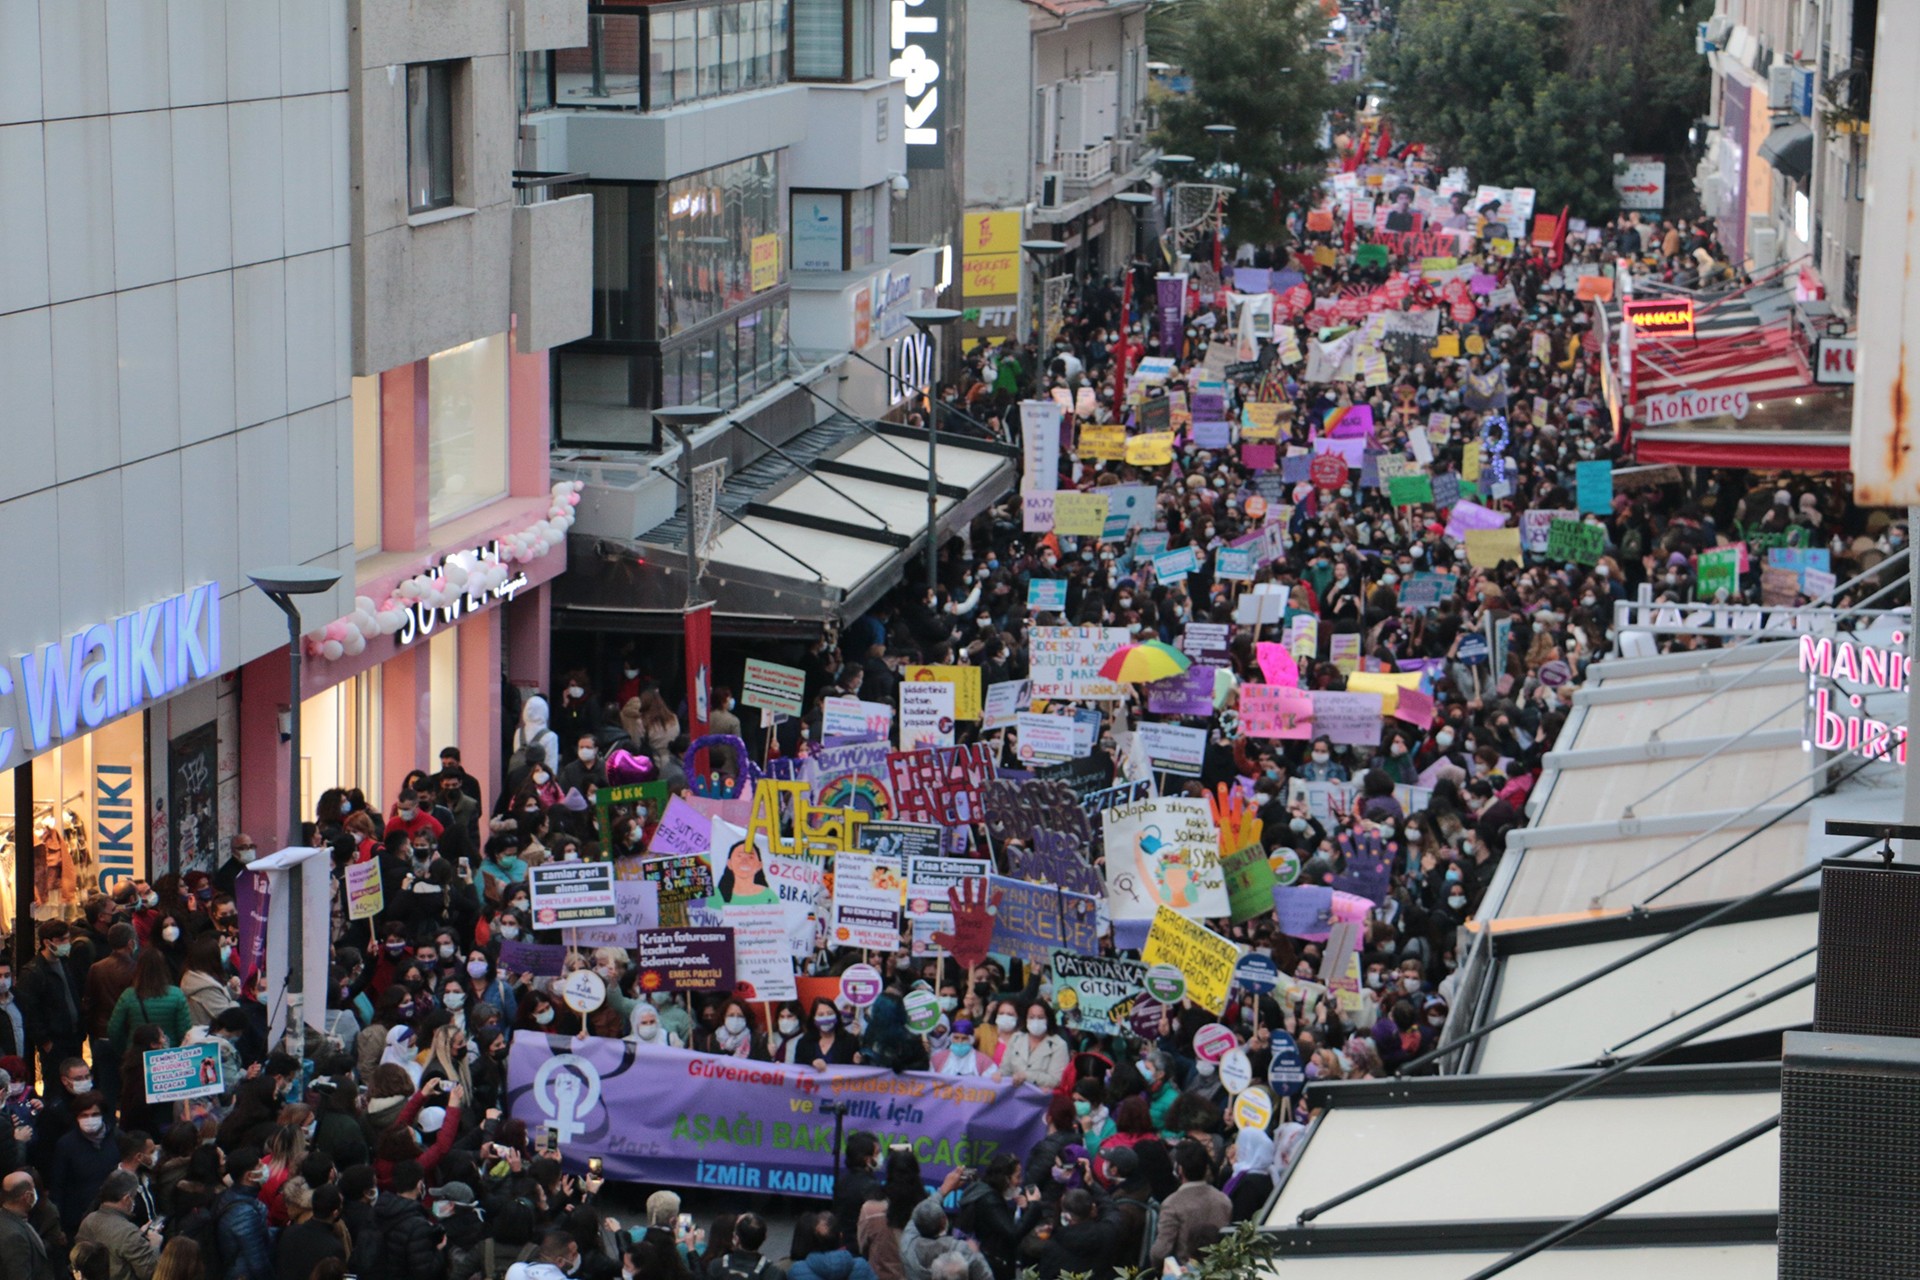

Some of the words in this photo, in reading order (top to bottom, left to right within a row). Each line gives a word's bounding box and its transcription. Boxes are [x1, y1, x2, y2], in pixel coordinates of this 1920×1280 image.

[542, 870, 577, 880] zamlar
[578, 867, 600, 879] geri
[639, 933, 673, 944] Krizin
[674, 931, 725, 942] faturasını
[640, 944, 687, 955] kadınlar
[641, 955, 709, 967] ödemeyecek
[669, 970, 691, 979] EMEK
[676, 979, 716, 987] KADINLAR
[689, 1059, 785, 1087] Güvenceli
[932, 1081, 996, 1105] Yaşam
[789, 1099, 814, 1113] ve
[671, 1111, 763, 1149] AŞAĞI
[696, 1158, 761, 1188] İZMİR
